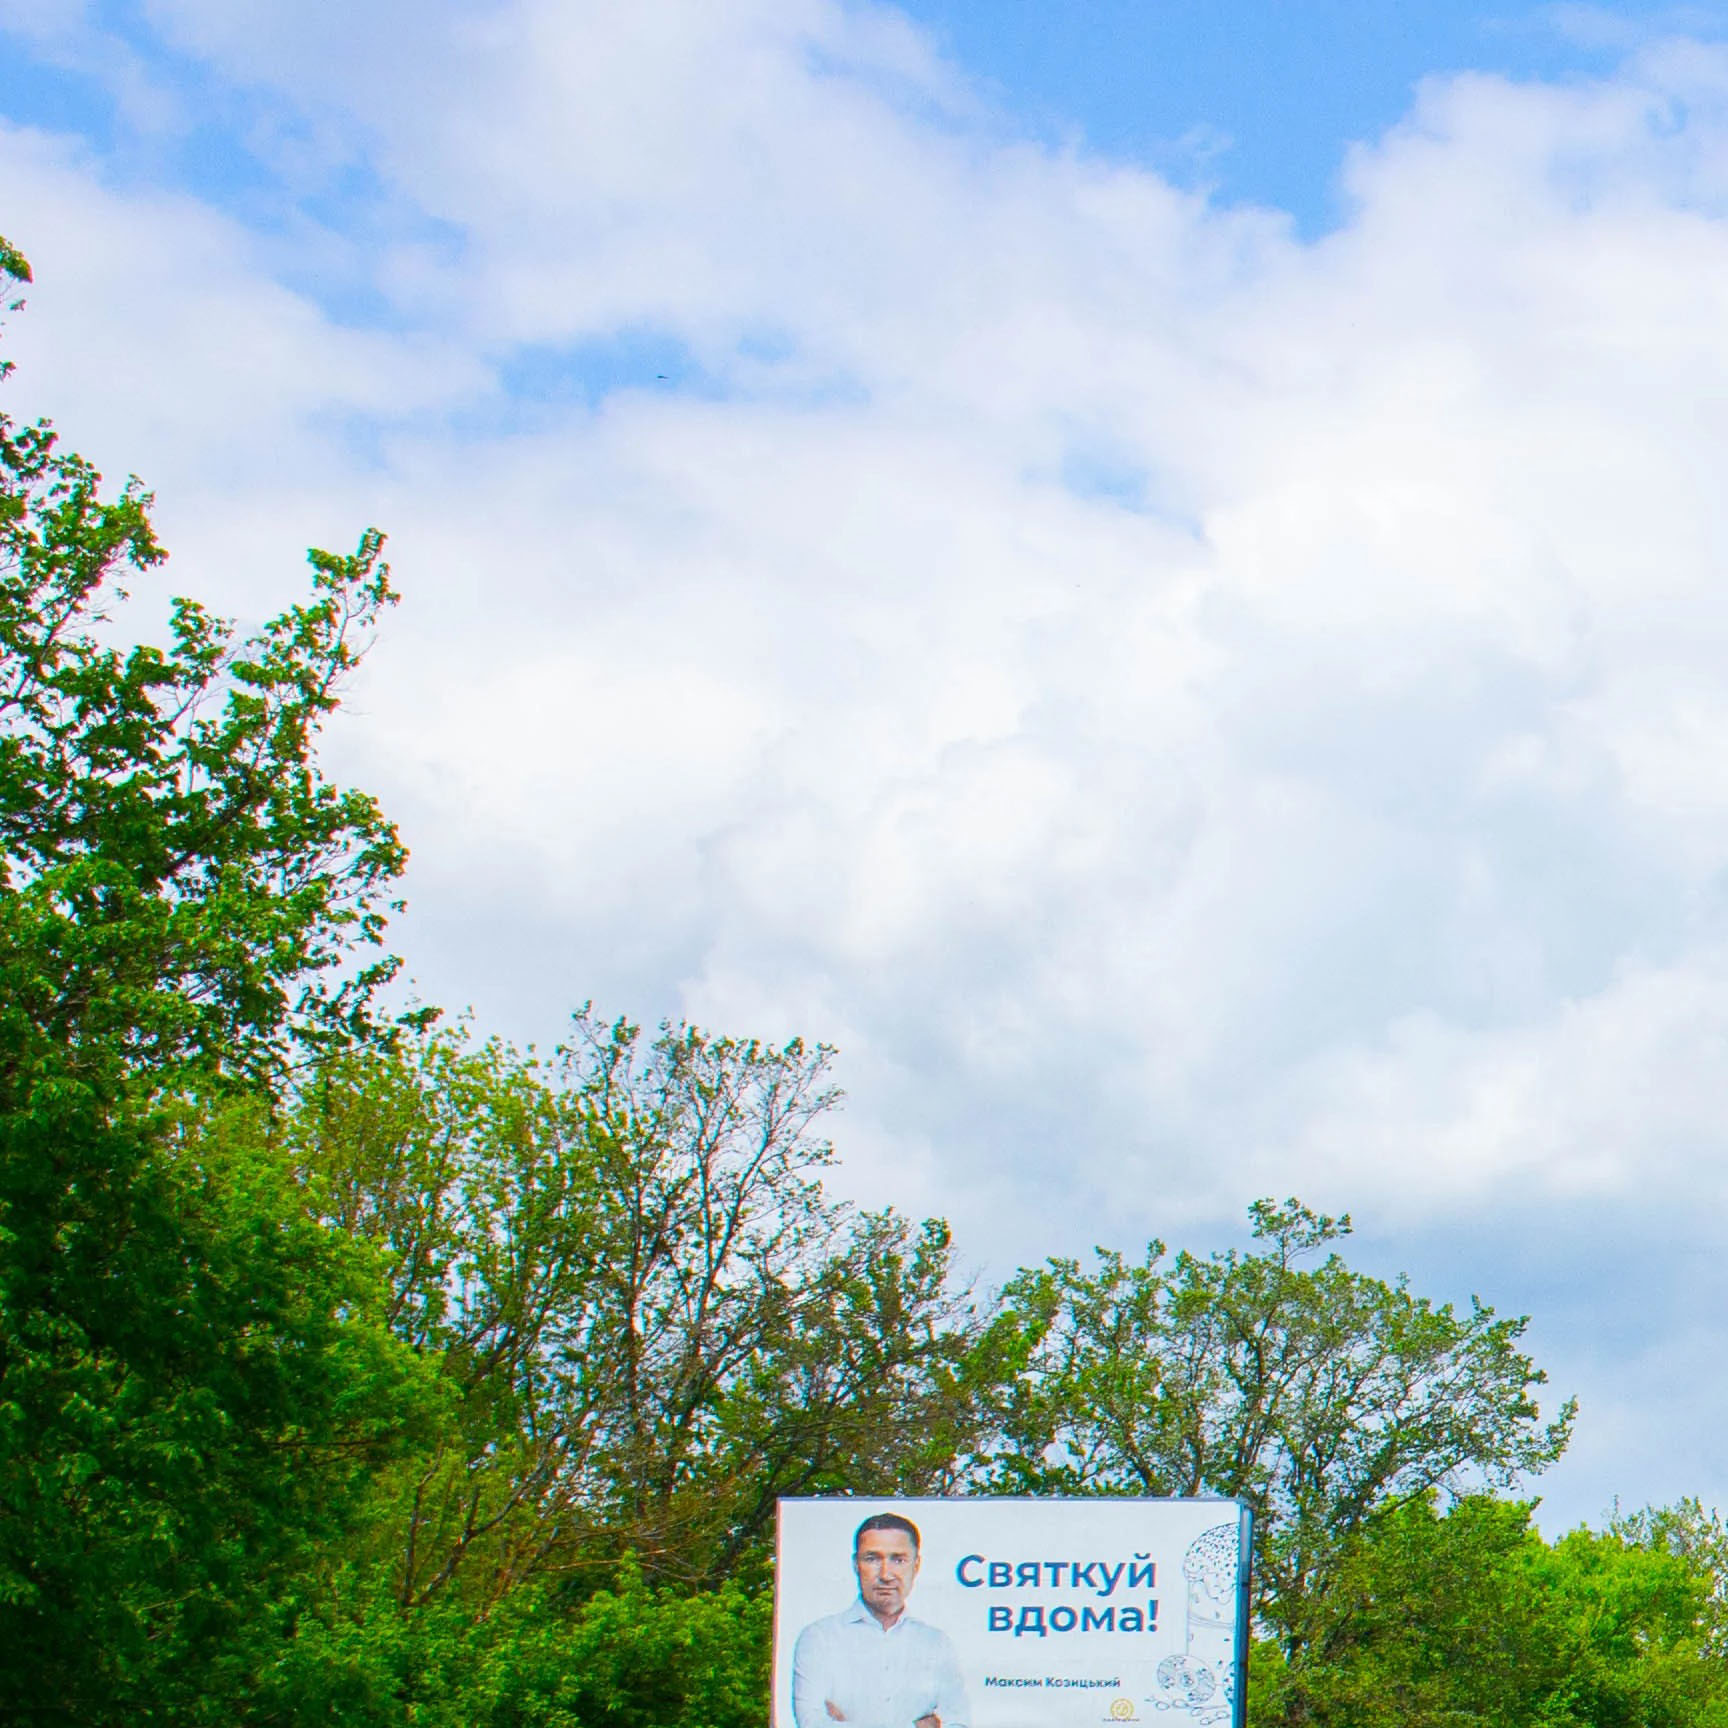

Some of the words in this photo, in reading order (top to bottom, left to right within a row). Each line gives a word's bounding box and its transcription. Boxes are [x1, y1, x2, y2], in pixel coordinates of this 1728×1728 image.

[955, 1552, 1157, 1597] Святкуй
[987, 1599, 1159, 1637] вдома!
[985, 1676, 1042, 1688] Максим
